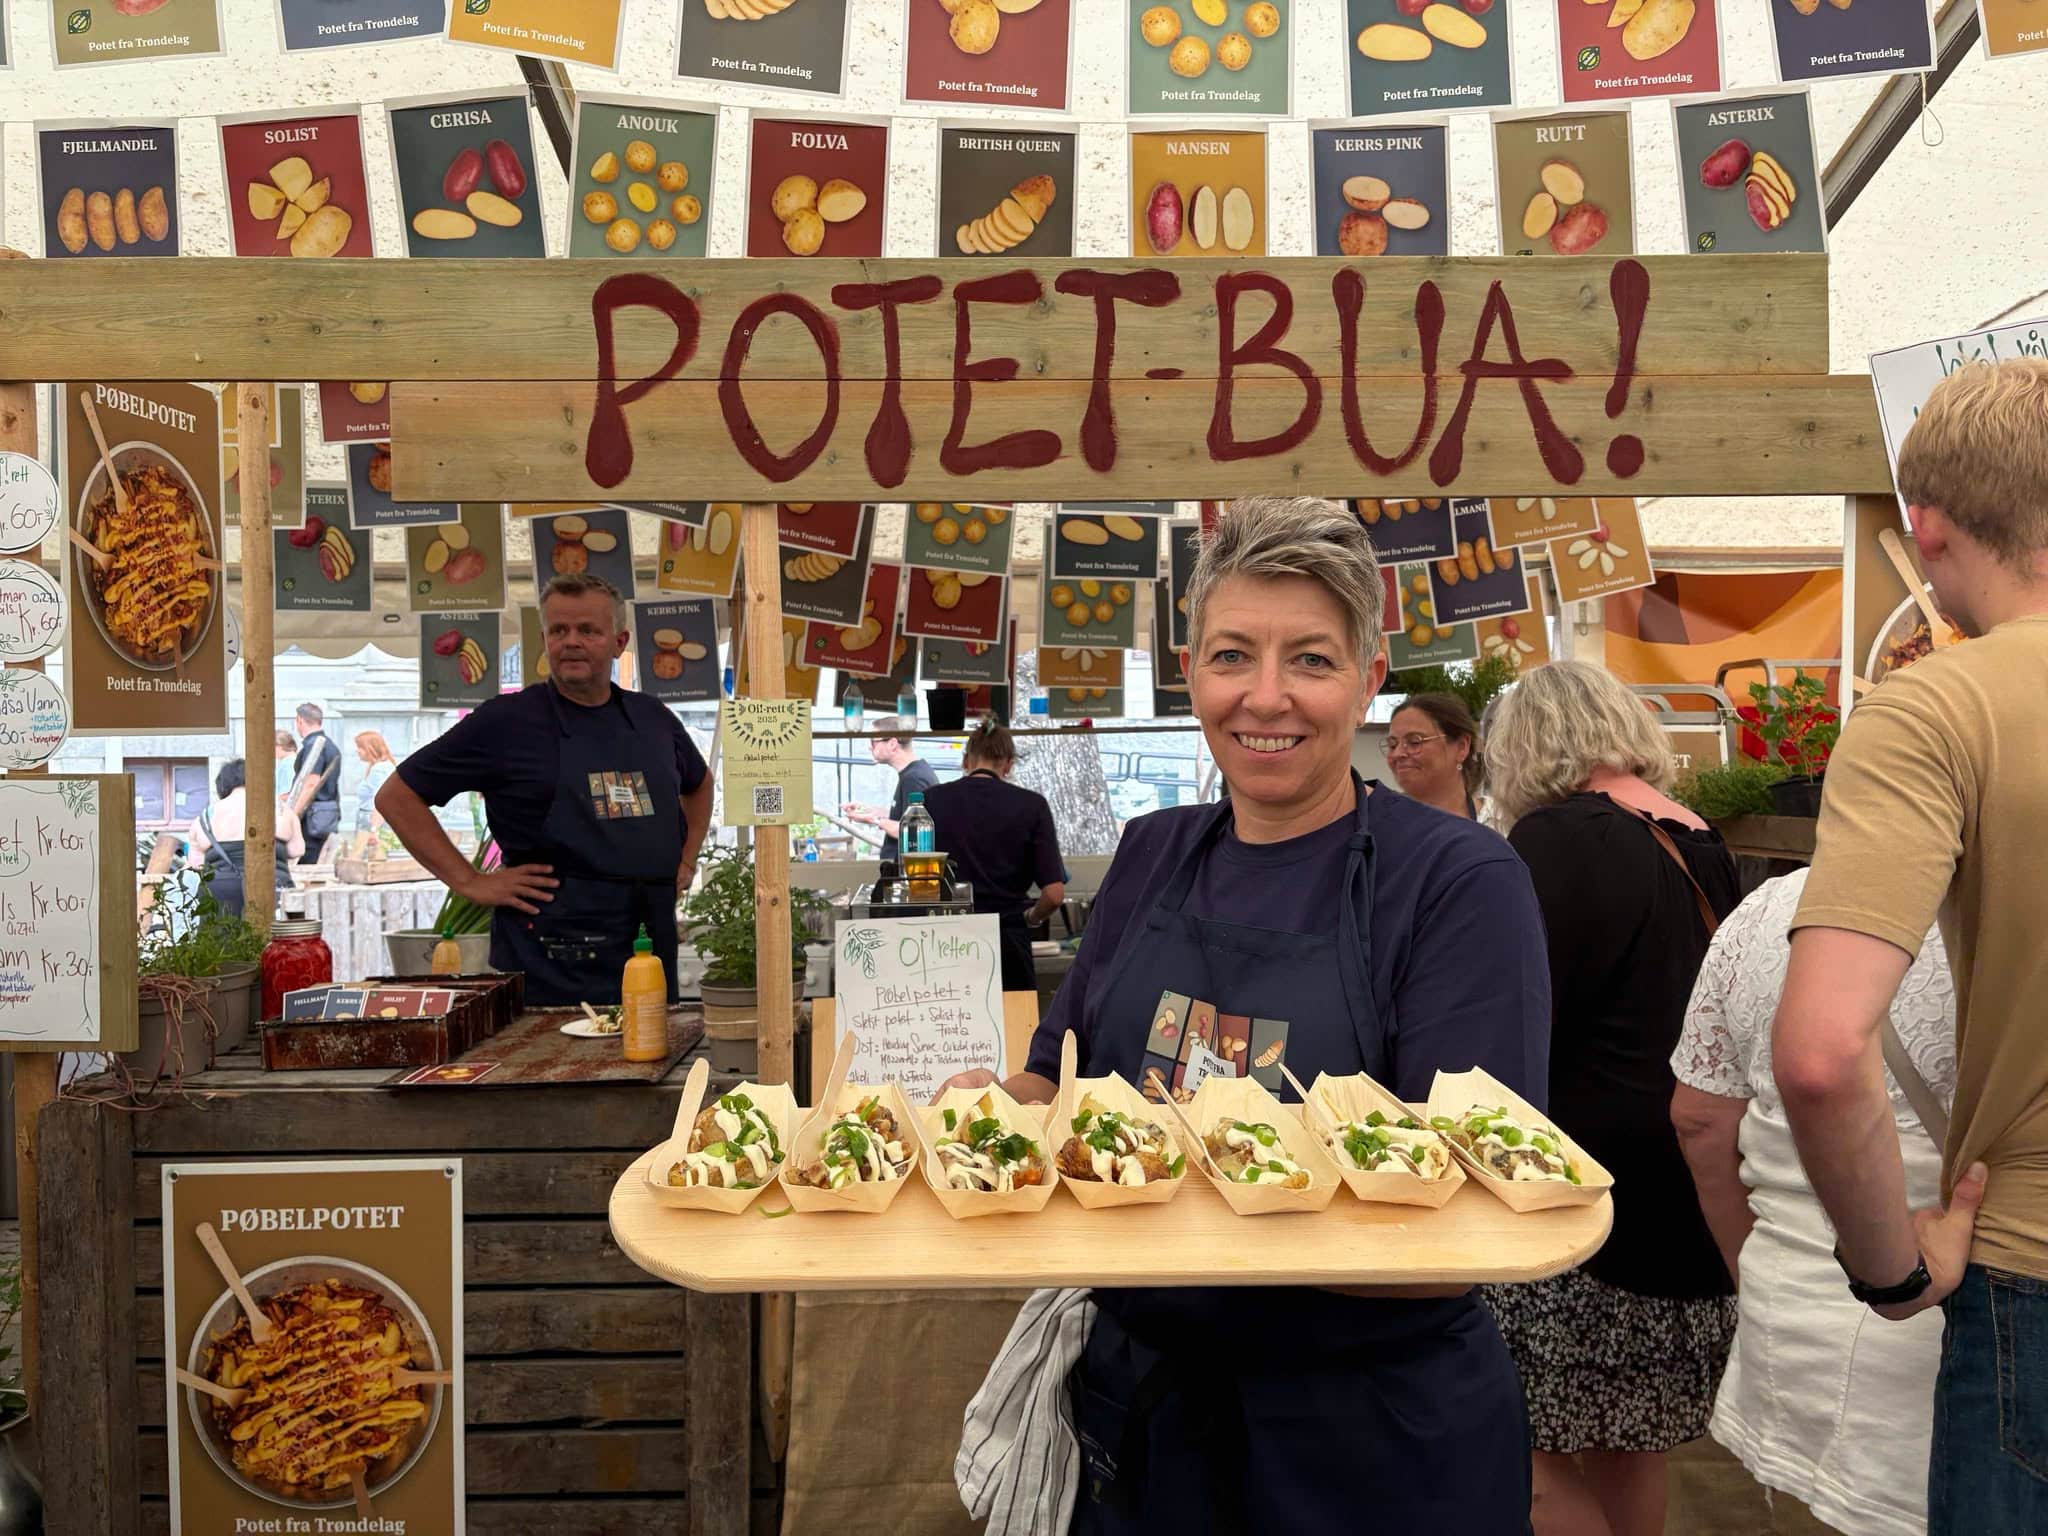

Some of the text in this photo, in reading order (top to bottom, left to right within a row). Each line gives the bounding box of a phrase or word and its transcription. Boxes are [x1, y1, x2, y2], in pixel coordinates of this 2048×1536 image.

[317, 15, 419, 35] Potet fra Trøndelag
[88, 35, 190, 52] Potet fra Trøndelag
[482, 22, 586, 51] Potet fra Trøndelag
[2017, 29, 2044, 42] Potet
[1810, 47, 1905, 66] Potet fra Trøndelag
[711, 56, 813, 80] Potet fra Trøndelag
[938, 80, 1039, 98] Potet fra Trøndelag
[1594, 72, 1693, 89] Potet fra Trøndelag
[1161, 89, 1261, 103] Potet fra Trøndelag
[1383, 84, 1483, 102] Potet fra Trøndelag
[430, 109, 493, 129] CERISA
[616, 114, 680, 134] ANOUK
[1707, 106, 1775, 127] ASTERIX
[264, 126, 319, 145] SOLIST
[790, 131, 849, 151] FOLVA
[1535, 124, 1587, 144] RUTT
[62, 138, 158, 156] FJELLMANDEL
[959, 136, 1061, 153] BRITISH QUEEN
[1166, 141, 1231, 156] NANSEN
[1335, 136, 1423, 152] KERRS PINK
[586, 259, 1650, 489] POTET-BUA!
[95, 383, 197, 434] PØBELPOTET
[346, 423, 369, 433] Potet
[368, 422, 381, 432] fra
[106, 676, 202, 697] Potet fra Trøndelag
[220, 1205, 404, 1232] PØBELPOTET
[235, 1516, 406, 1536] Potet fra Trøndelag
